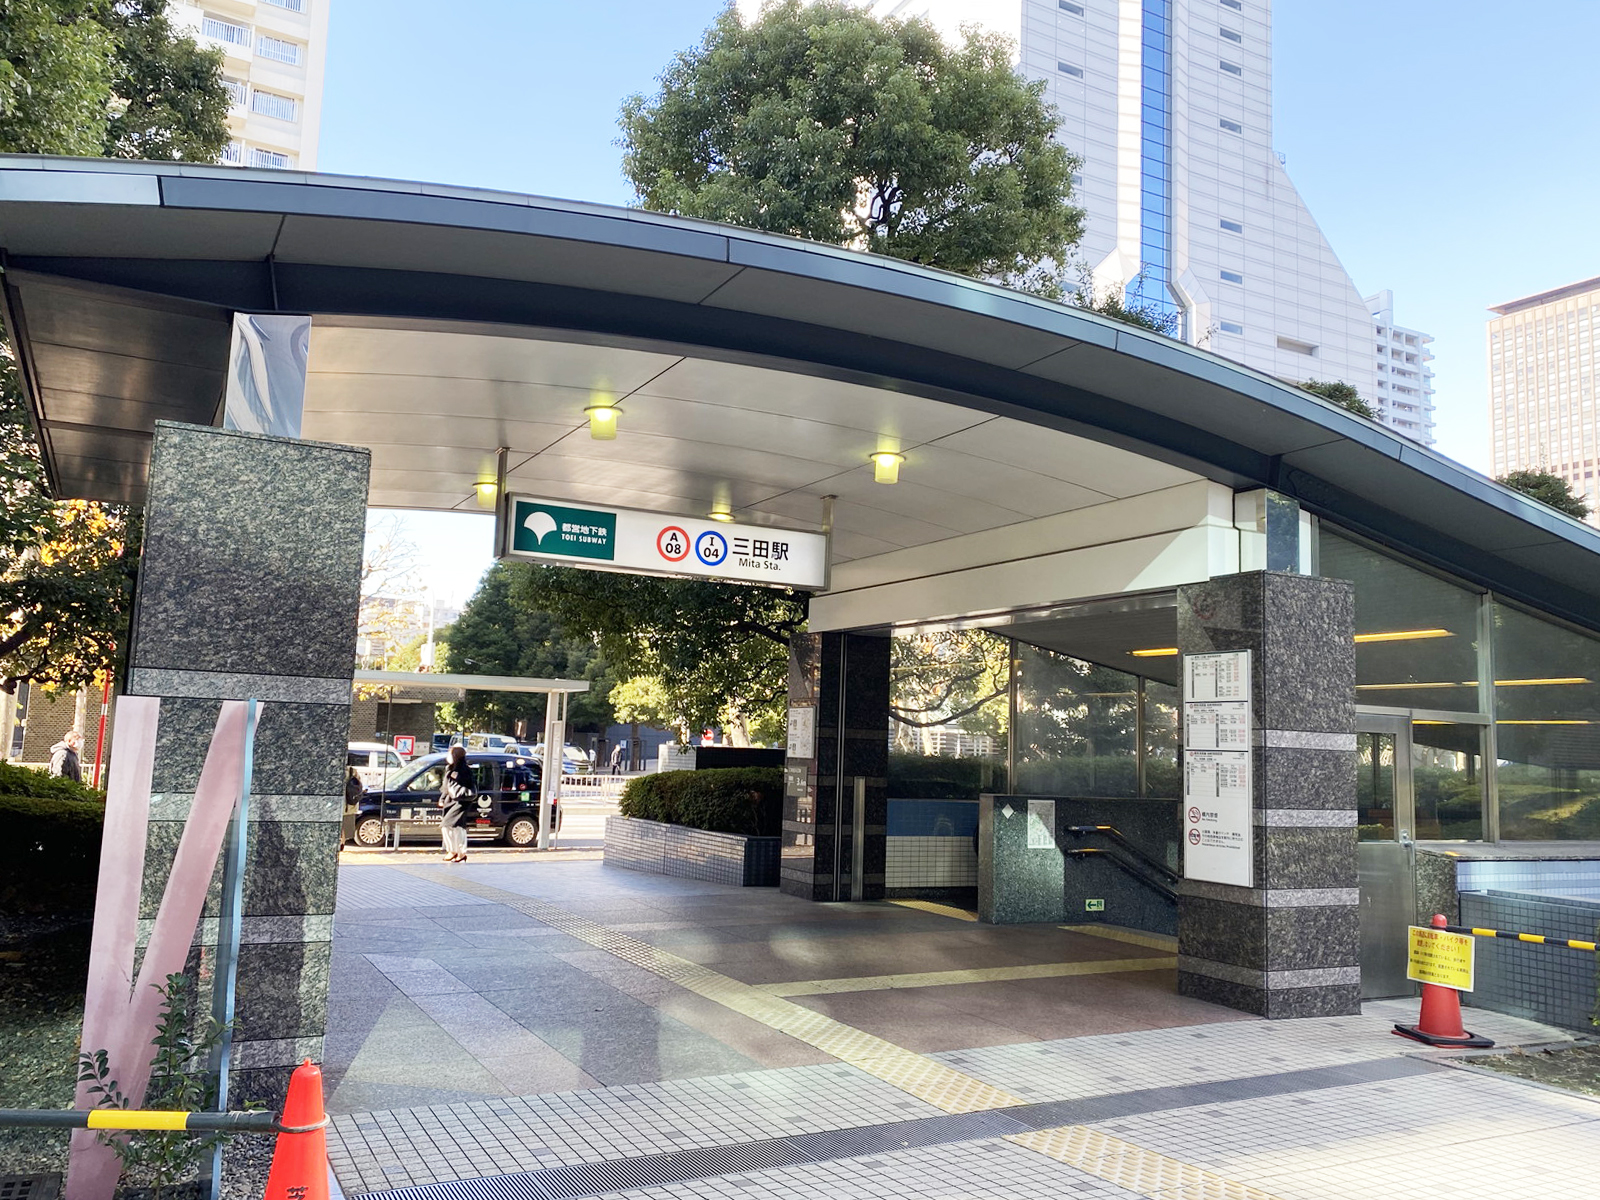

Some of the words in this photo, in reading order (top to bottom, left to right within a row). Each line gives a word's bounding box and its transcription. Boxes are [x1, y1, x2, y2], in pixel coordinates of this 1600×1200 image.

[562, 522, 607, 537] 都営地下鉄
[561, 533, 577, 542] TOEI
[578, 535, 607, 545] SUBWAY
[669, 532, 679, 542] A
[709, 536, 715, 547] I
[665, 543, 682, 555] 08
[703, 547, 719, 559] 04
[732, 537, 789, 561] 三田駅
[738, 558, 761, 569] Mita
[763, 560, 781, 571] Sta.
